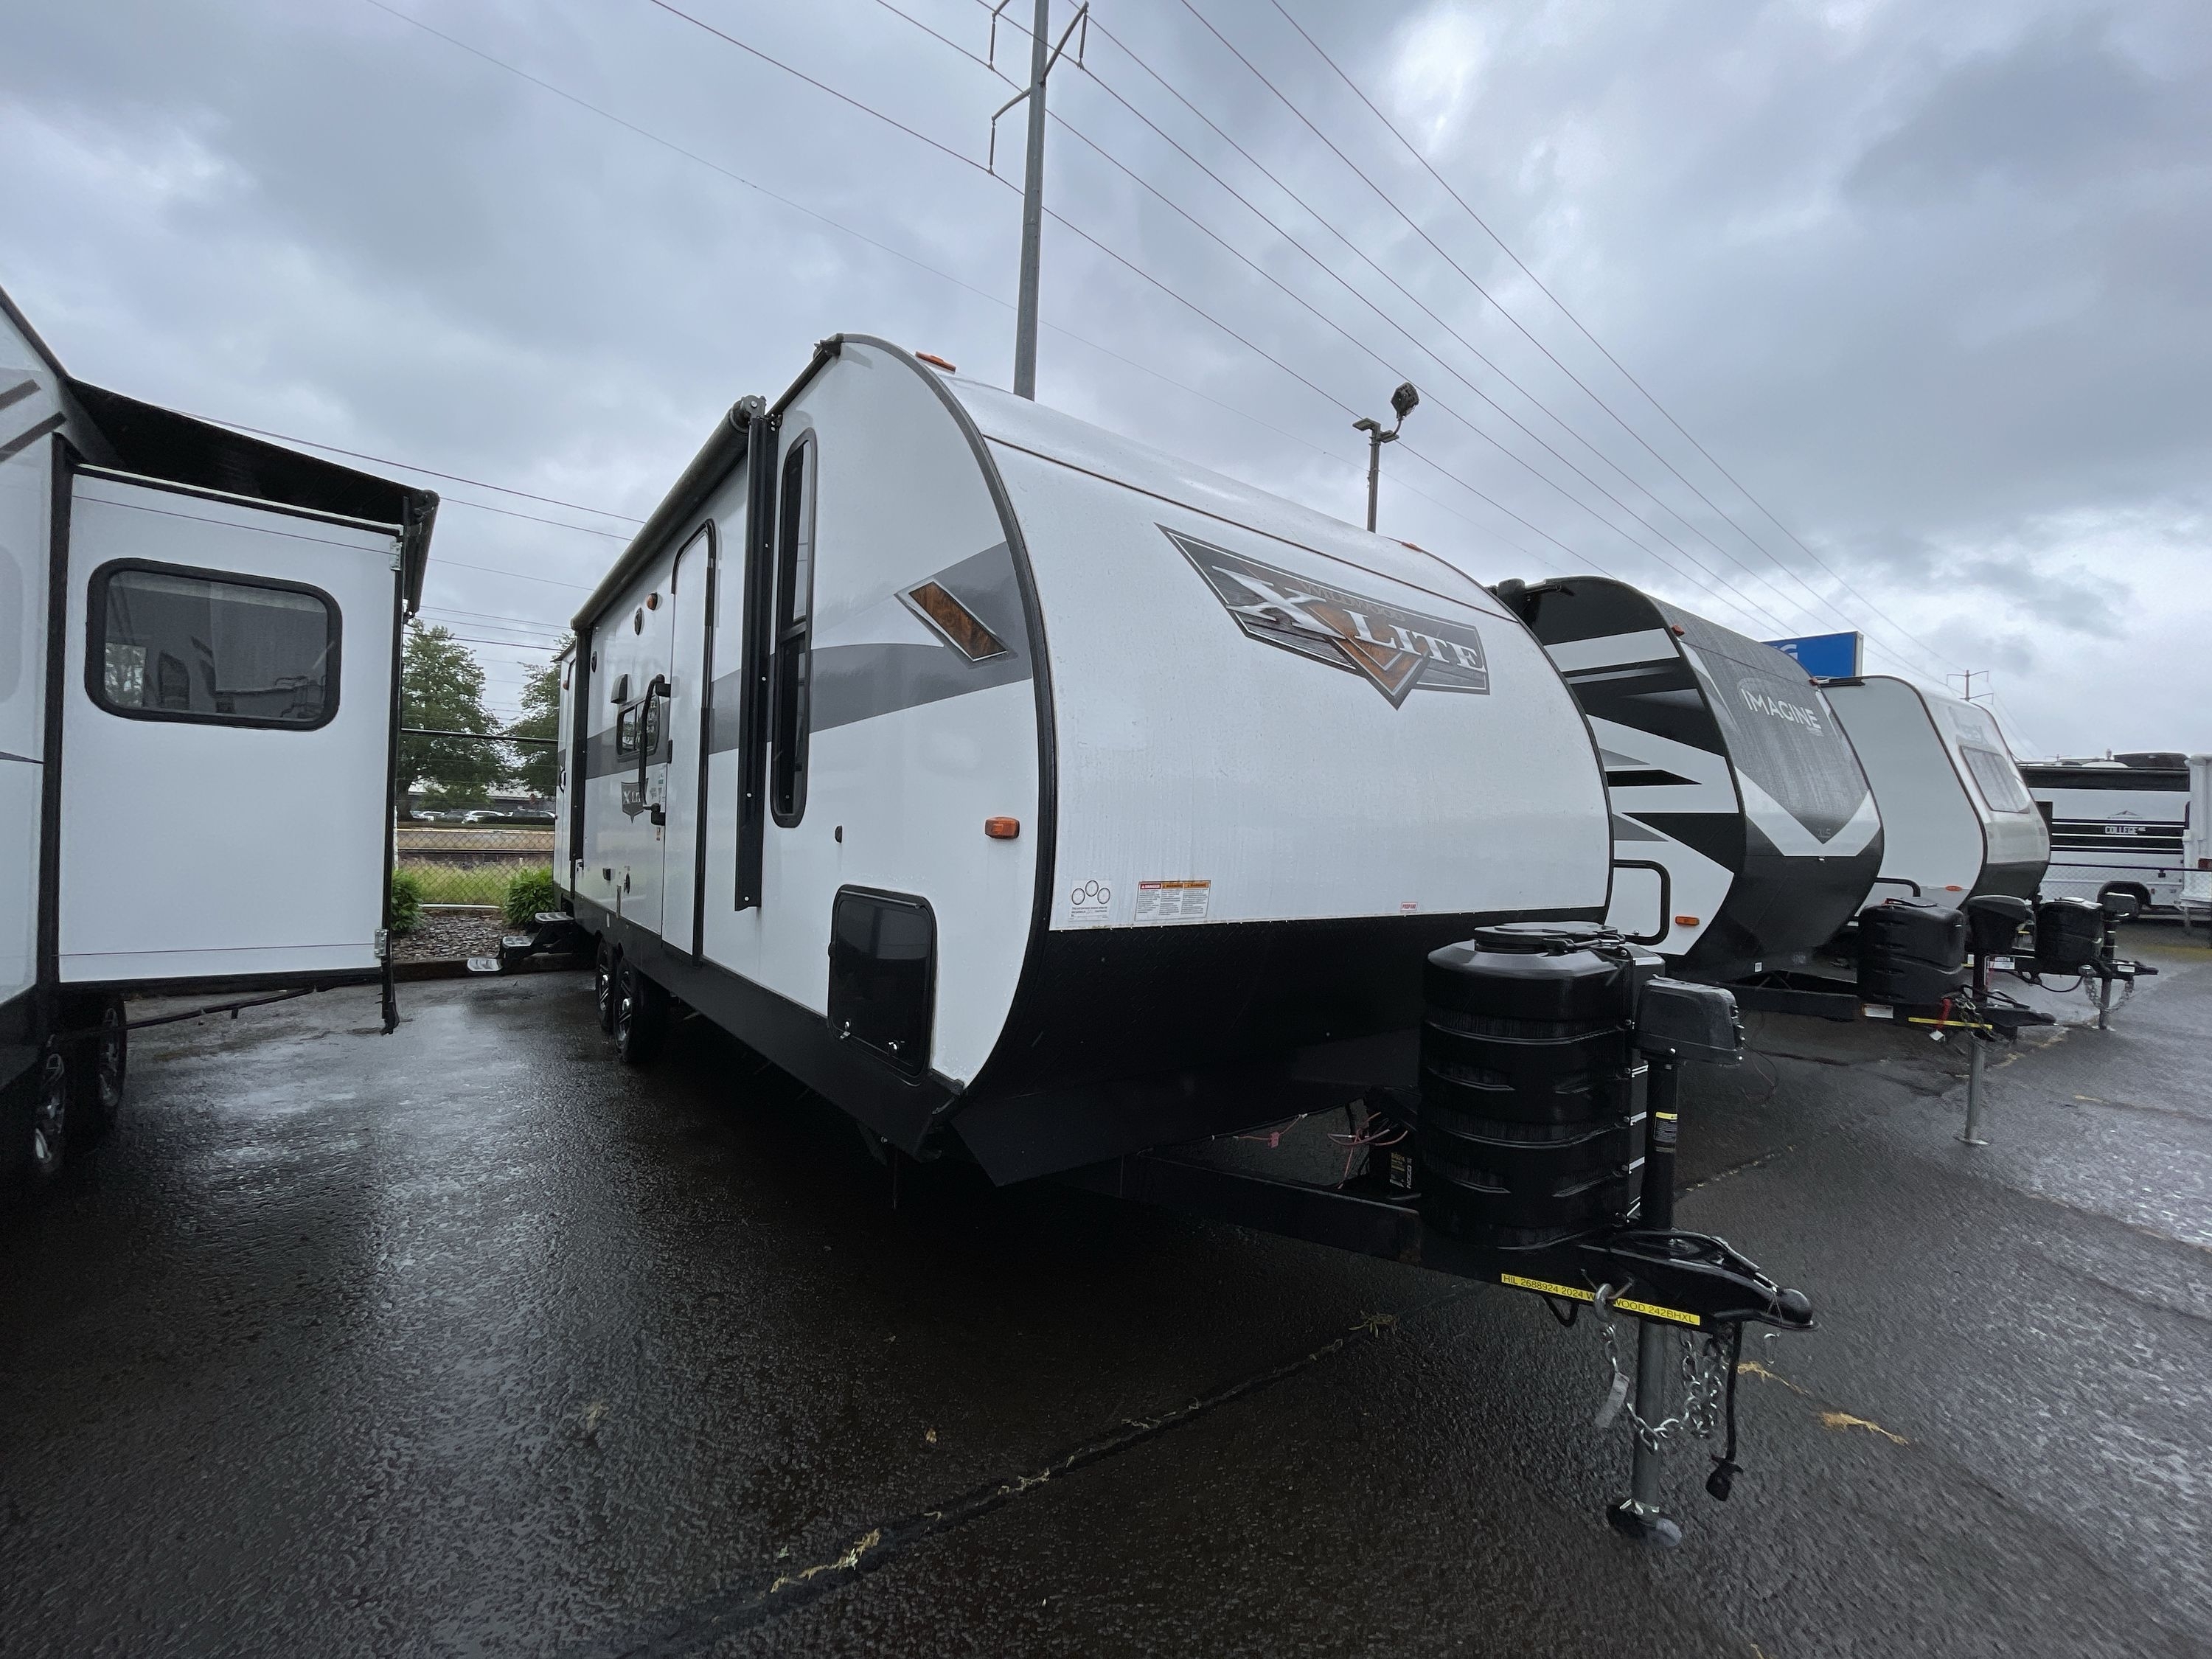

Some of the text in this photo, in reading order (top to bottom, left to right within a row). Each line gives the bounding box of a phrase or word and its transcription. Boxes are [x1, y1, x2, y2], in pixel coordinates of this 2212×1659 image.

[1211, 565, 1486, 672] X LITE
[1741, 688, 1821, 729] IMAGINE
[1503, 1274, 1697, 1324] HIL 2688924 2024 WWOOD 242BHXL
